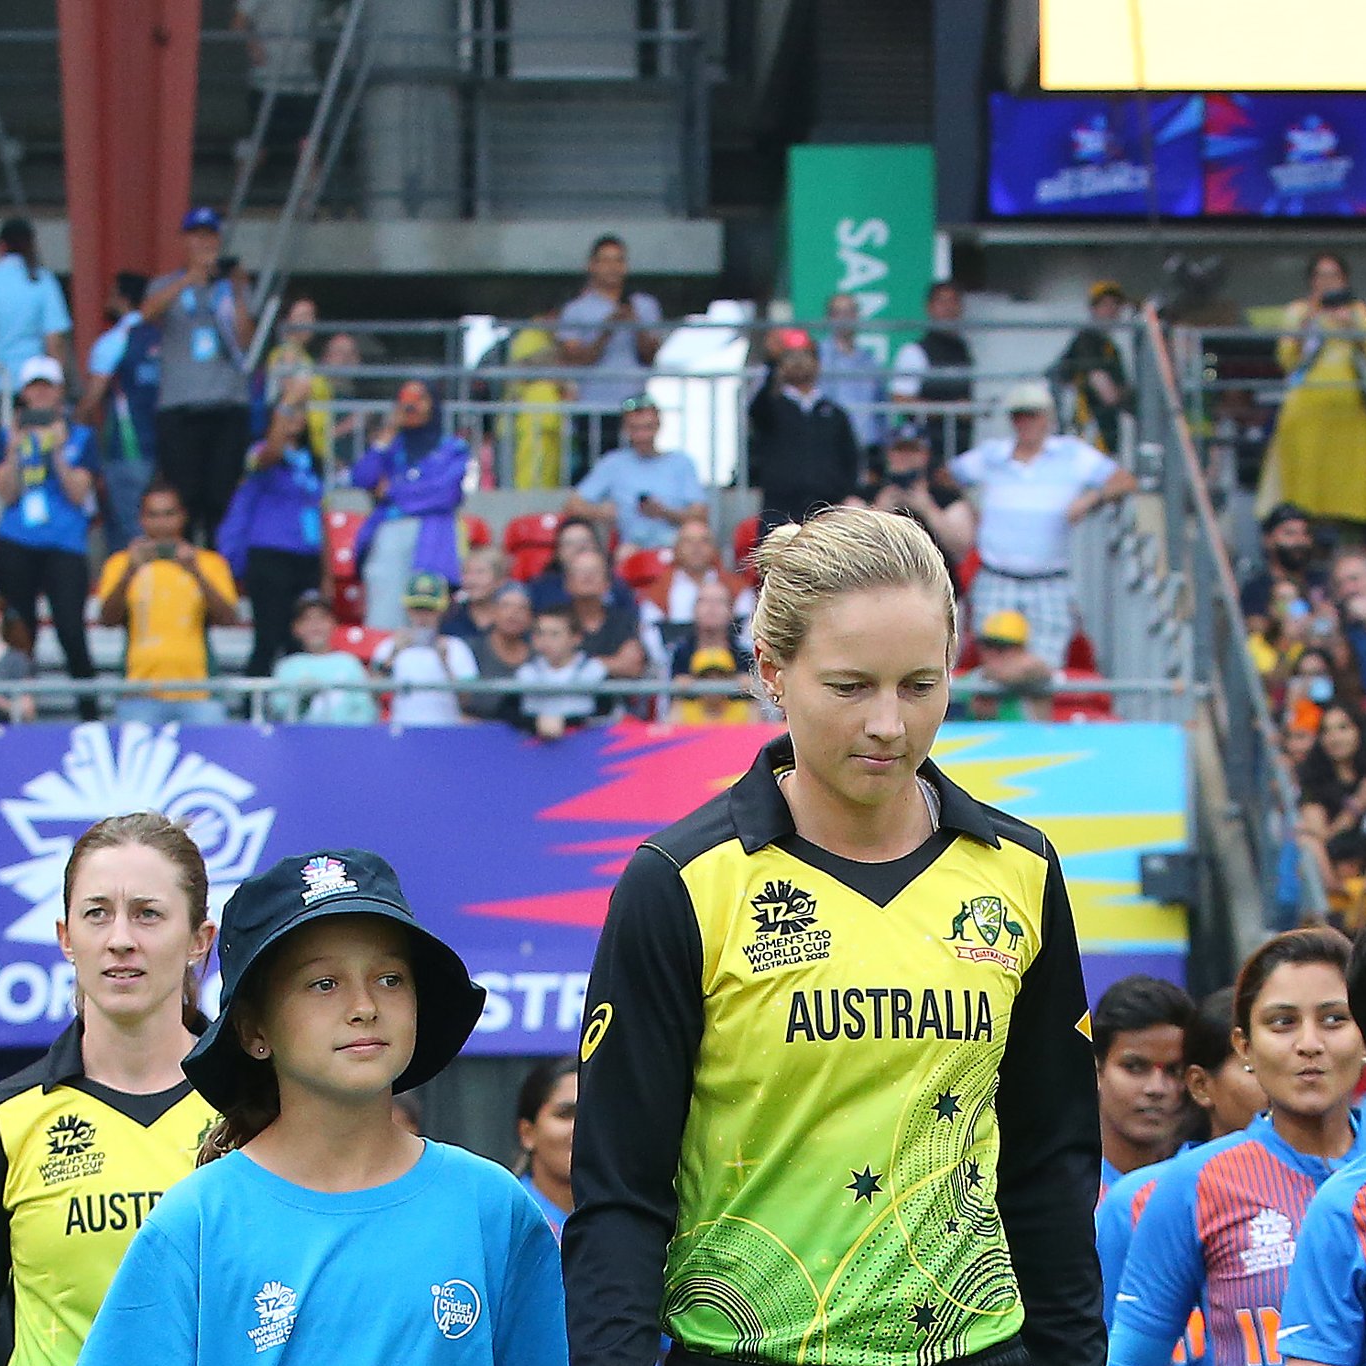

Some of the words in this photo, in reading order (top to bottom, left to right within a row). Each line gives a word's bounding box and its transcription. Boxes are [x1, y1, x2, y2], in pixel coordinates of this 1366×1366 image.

[742, 934, 804, 956] WOMEN'S
[805, 930, 831, 942] T20
[748, 945, 801, 965] WORLD
[803, 940, 830, 953] CUP
[752, 956, 803, 974] AUSTRALIA
[804, 951, 830, 962] 2020
[785, 987, 993, 1043] AUSTRALIA
[38, 1156, 84, 1174] WOMEN'S
[86, 1151, 105, 1161] T20
[41, 1166, 80, 1181] WORLD
[81, 1160, 104, 1171] CUP
[440, 1298, 472, 1314] Cricket
[254, 1329, 284, 1346] WORLD
